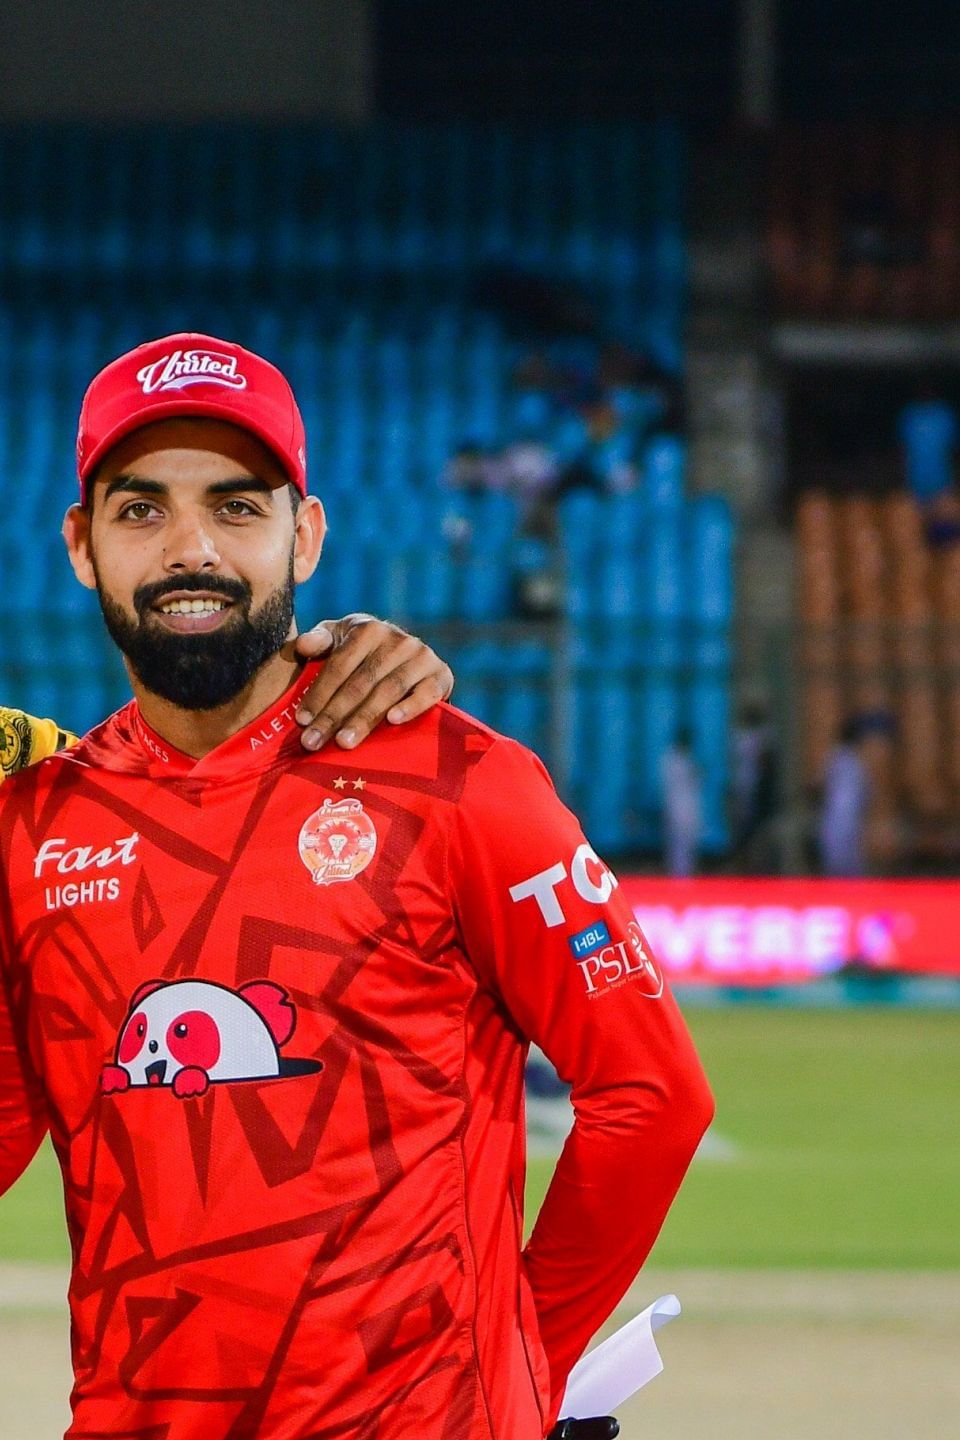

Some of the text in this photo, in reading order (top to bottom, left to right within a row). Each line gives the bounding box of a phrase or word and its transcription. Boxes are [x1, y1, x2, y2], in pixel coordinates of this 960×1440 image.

[137, 350, 246, 393] United
[34, 832, 139, 878] Fast
[46, 878, 120, 909] LIGHTS
[509, 844, 619, 928] TC
[574, 929, 605, 952] HBL
[577, 941, 644, 993] PSL
